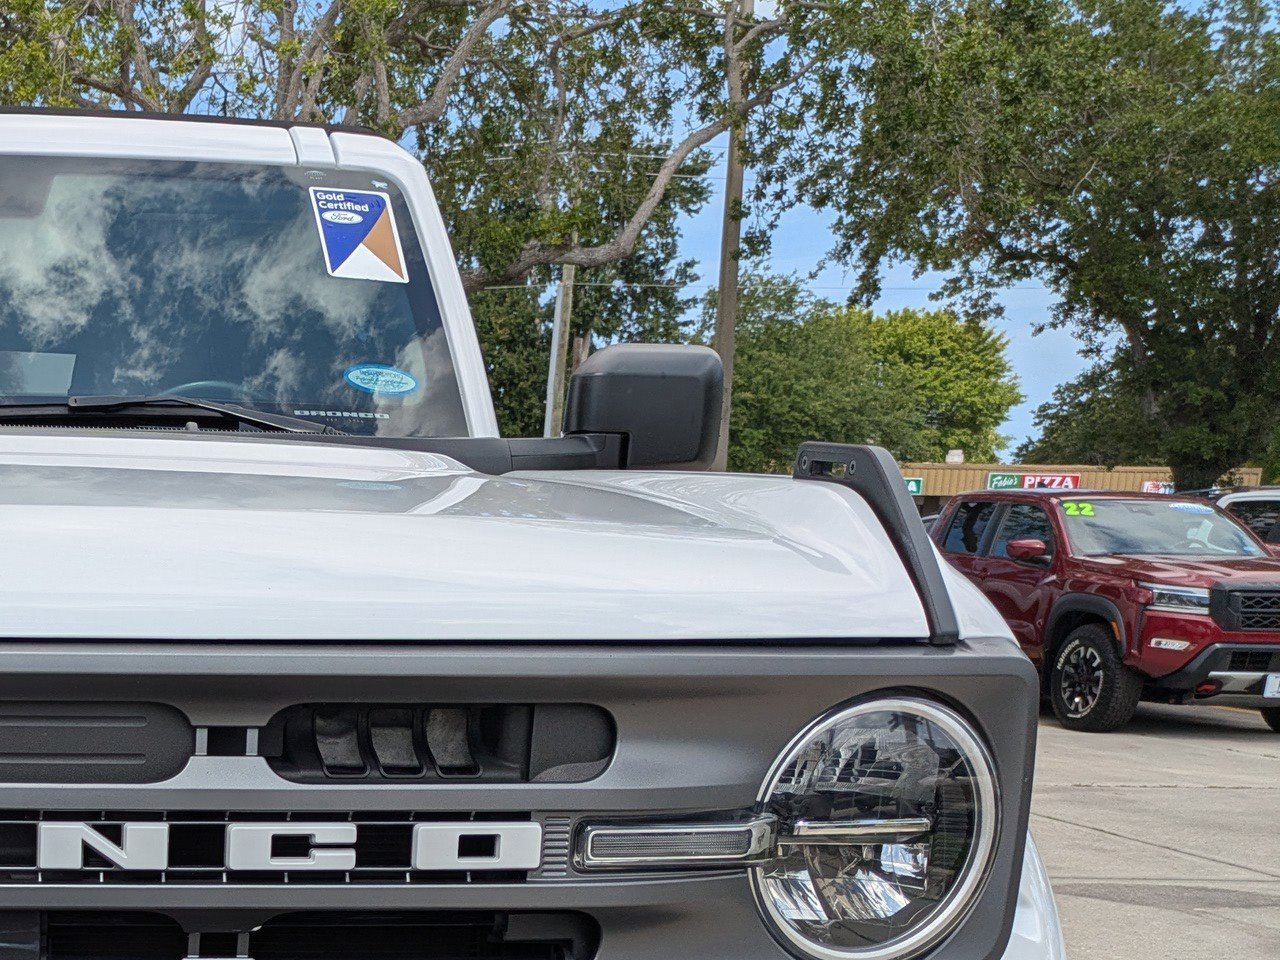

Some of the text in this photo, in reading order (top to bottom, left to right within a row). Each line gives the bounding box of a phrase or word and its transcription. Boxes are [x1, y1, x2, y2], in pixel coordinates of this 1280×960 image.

[316, 192, 345, 202] Gold
[318, 201, 370, 212] Certified
[294, 410, 390, 419] BRONCO
[991, 475, 1074, 489] Fabio's PIZZA
[1062, 502, 1095, 516] 22
